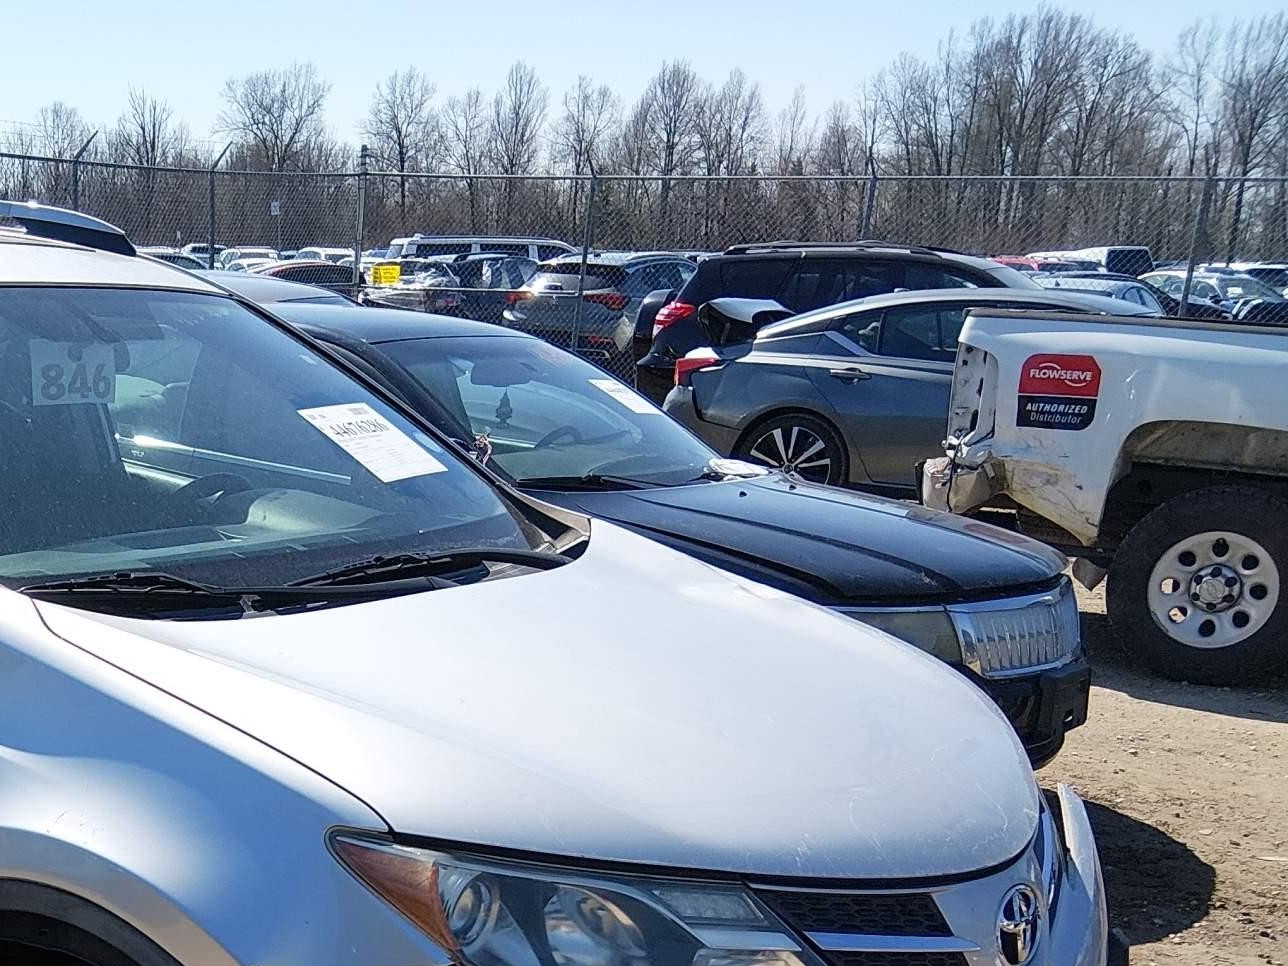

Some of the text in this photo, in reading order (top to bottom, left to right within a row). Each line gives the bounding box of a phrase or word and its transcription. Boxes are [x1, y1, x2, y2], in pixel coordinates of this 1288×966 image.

[1029, 368, 1092, 381] FLOWSERVE
[40, 363, 111, 400] 846
[1025, 402, 1088, 414] AUTHORIZED
[1030, 411, 1083, 424] Distributor
[329, 418, 390, 438] 44676286
